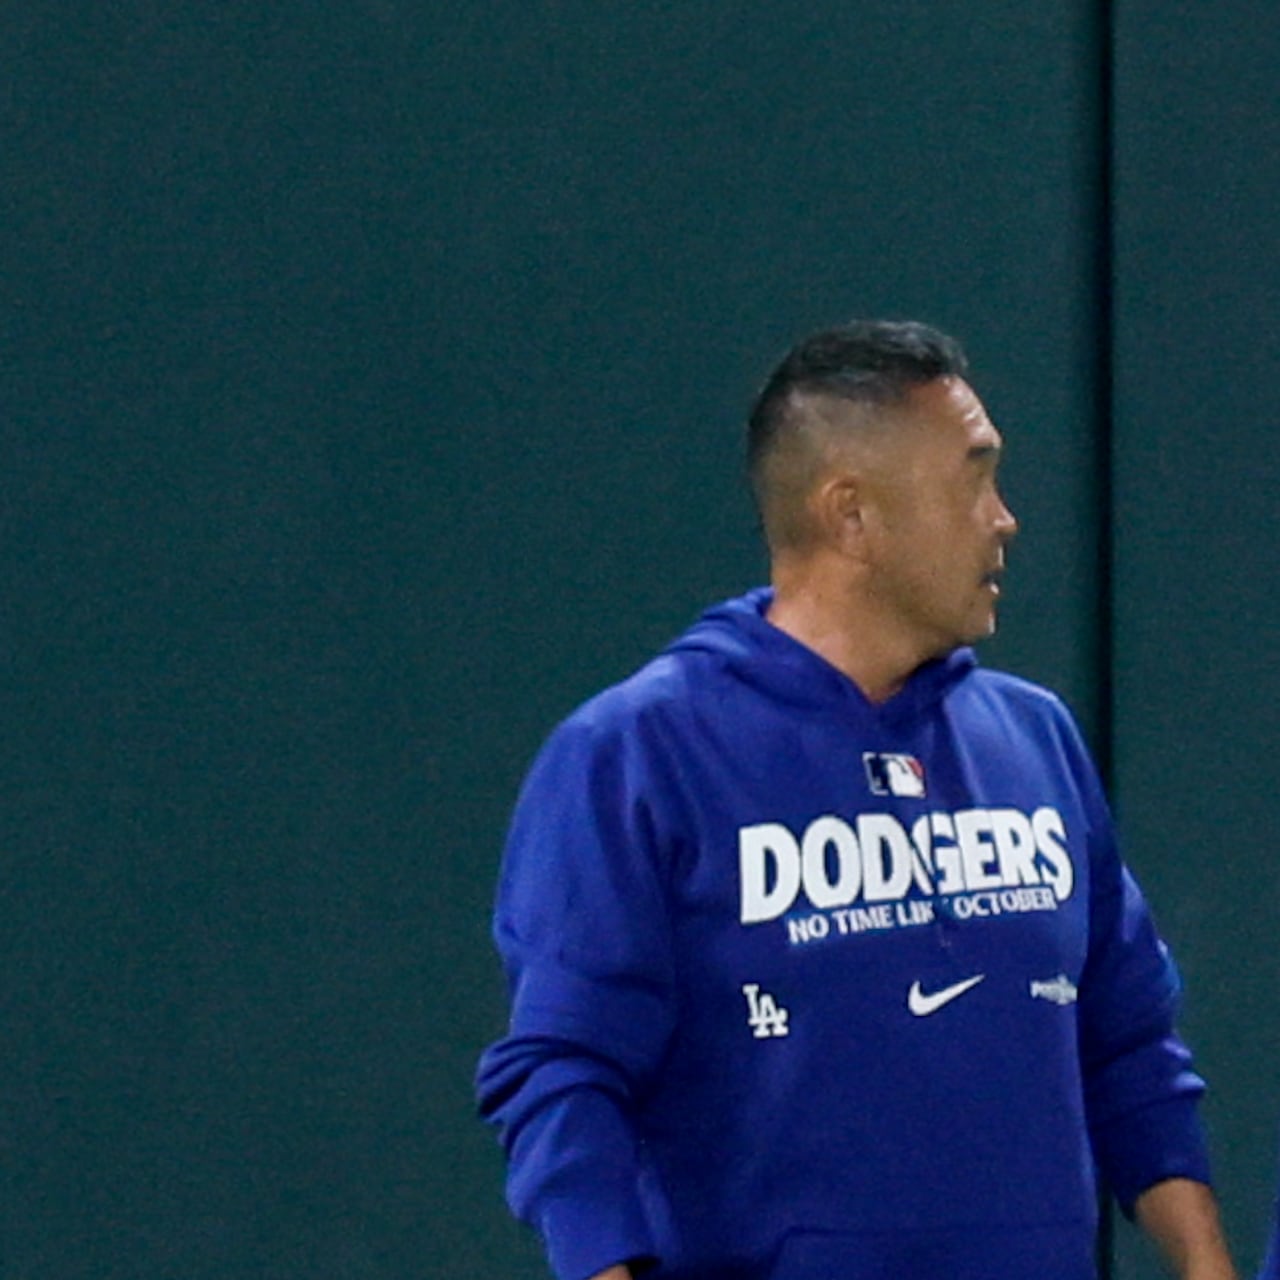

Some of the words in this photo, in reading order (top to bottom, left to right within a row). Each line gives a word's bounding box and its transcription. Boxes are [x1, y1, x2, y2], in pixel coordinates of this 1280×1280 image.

[739, 808, 1073, 924] DODGERS
[787, 913, 830, 945] NO
[832, 904, 894, 935] TIME
[896, 900, 948, 926] LIK
[953, 887, 1058, 919] OCTOBER
[742, 983, 789, 1039] LA
